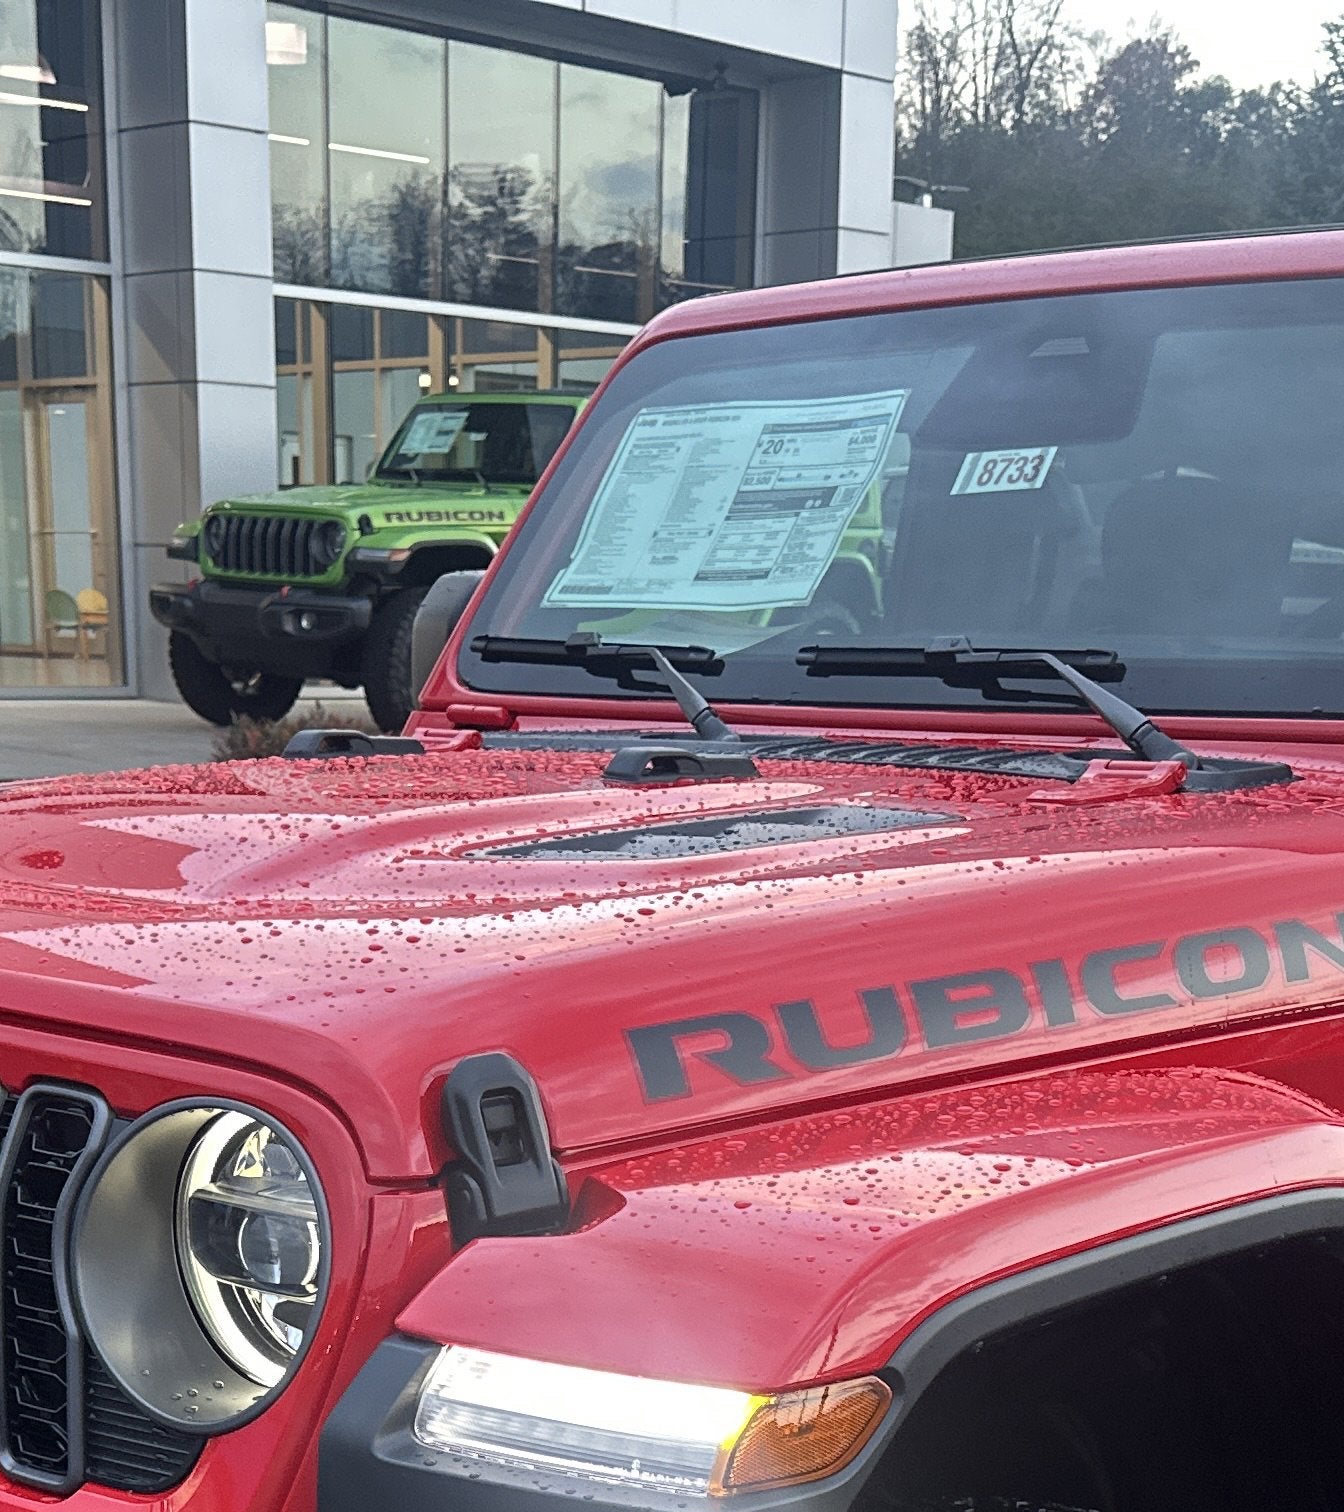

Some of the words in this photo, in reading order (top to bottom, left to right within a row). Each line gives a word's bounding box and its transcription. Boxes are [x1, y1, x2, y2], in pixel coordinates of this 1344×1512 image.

[761, 439, 784, 455] 20
[976, 454, 1046, 487] 8733
[383, 510, 506, 523] RUBICON
